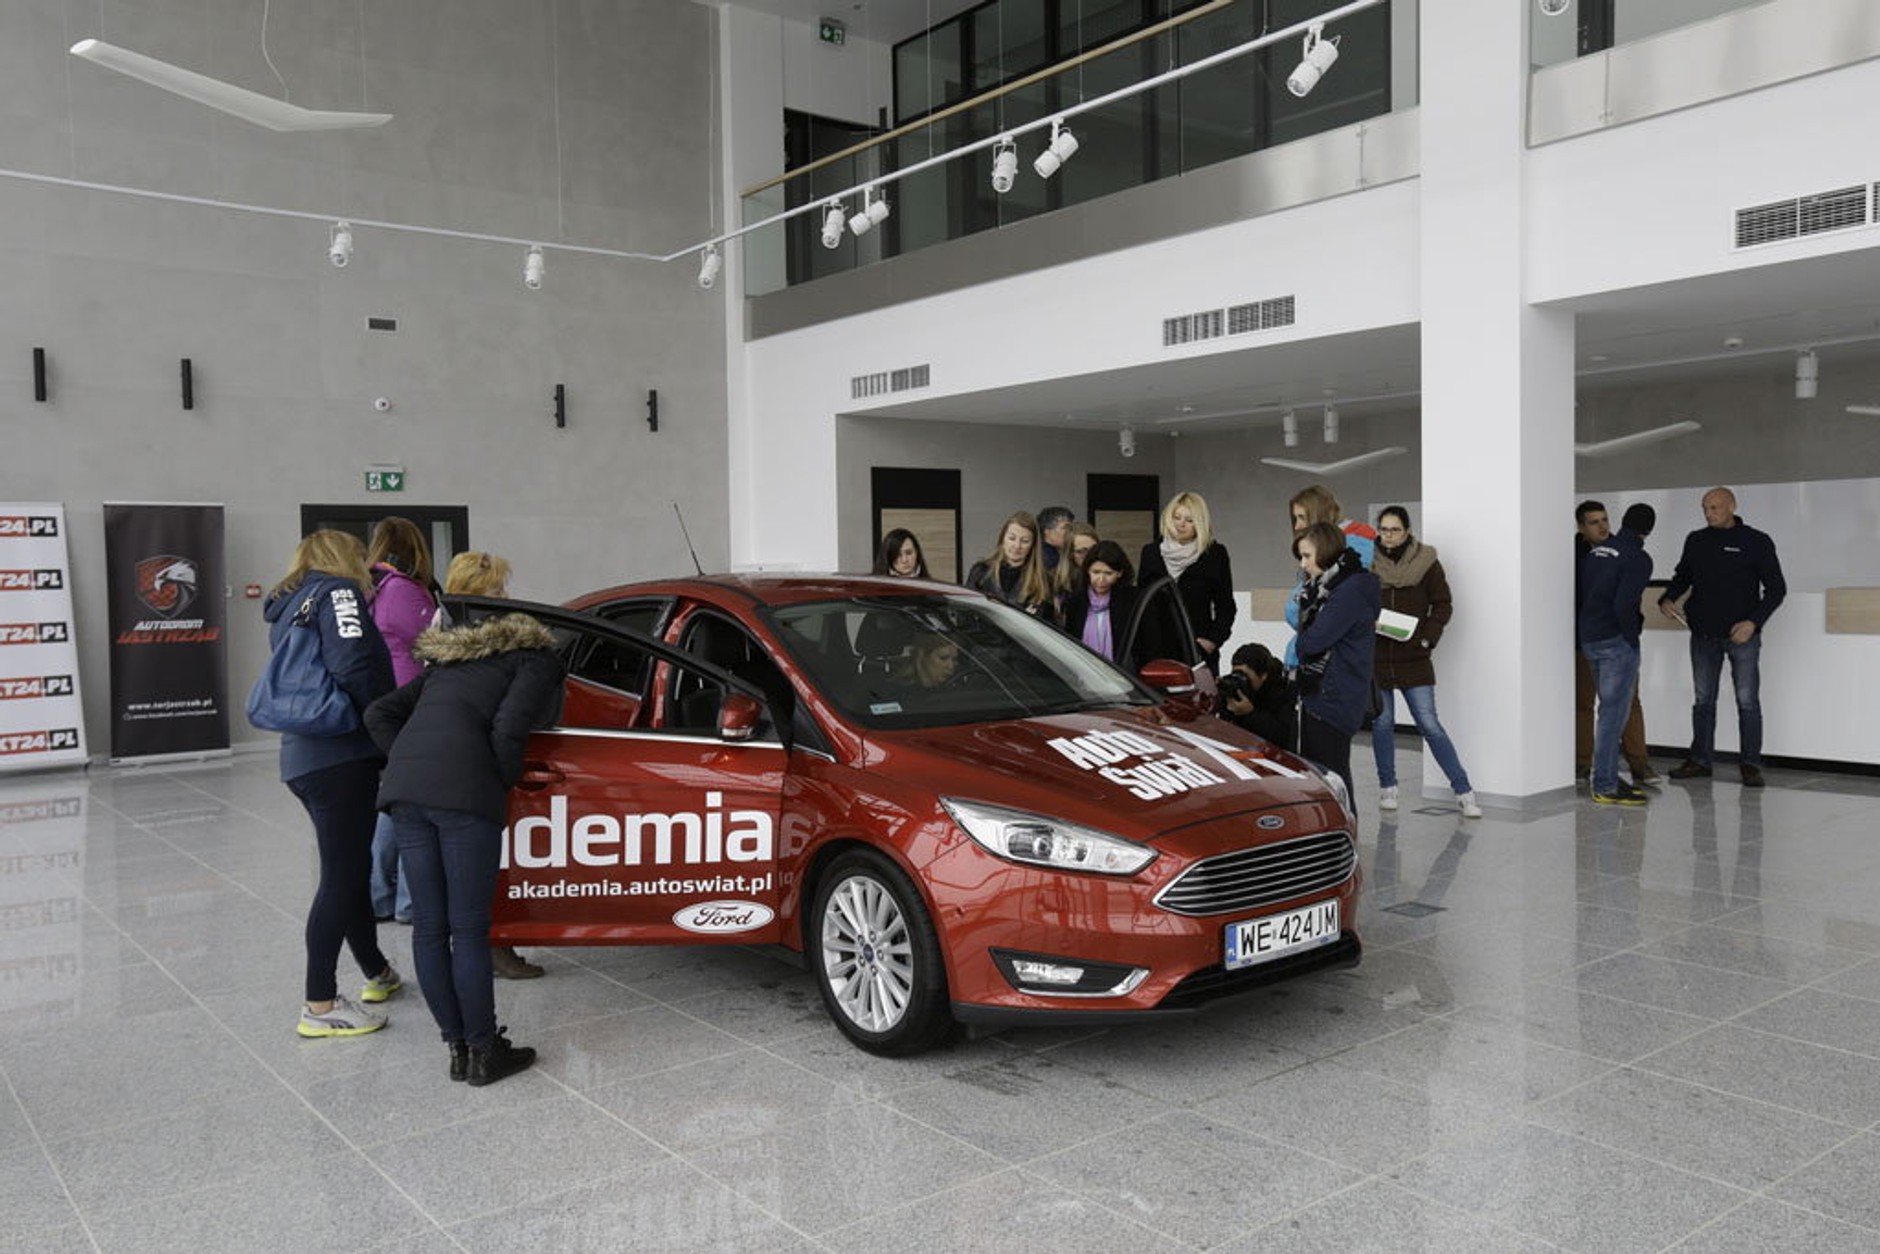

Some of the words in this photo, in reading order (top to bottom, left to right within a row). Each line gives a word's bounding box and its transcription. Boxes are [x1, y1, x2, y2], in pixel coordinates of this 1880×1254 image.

[508, 872, 773, 900] akademia.autoswiat.pl
[692, 906, 755, 927] Ford
[1241, 921, 1271, 956] WE
[1280, 903, 1336, 945] 424JM
